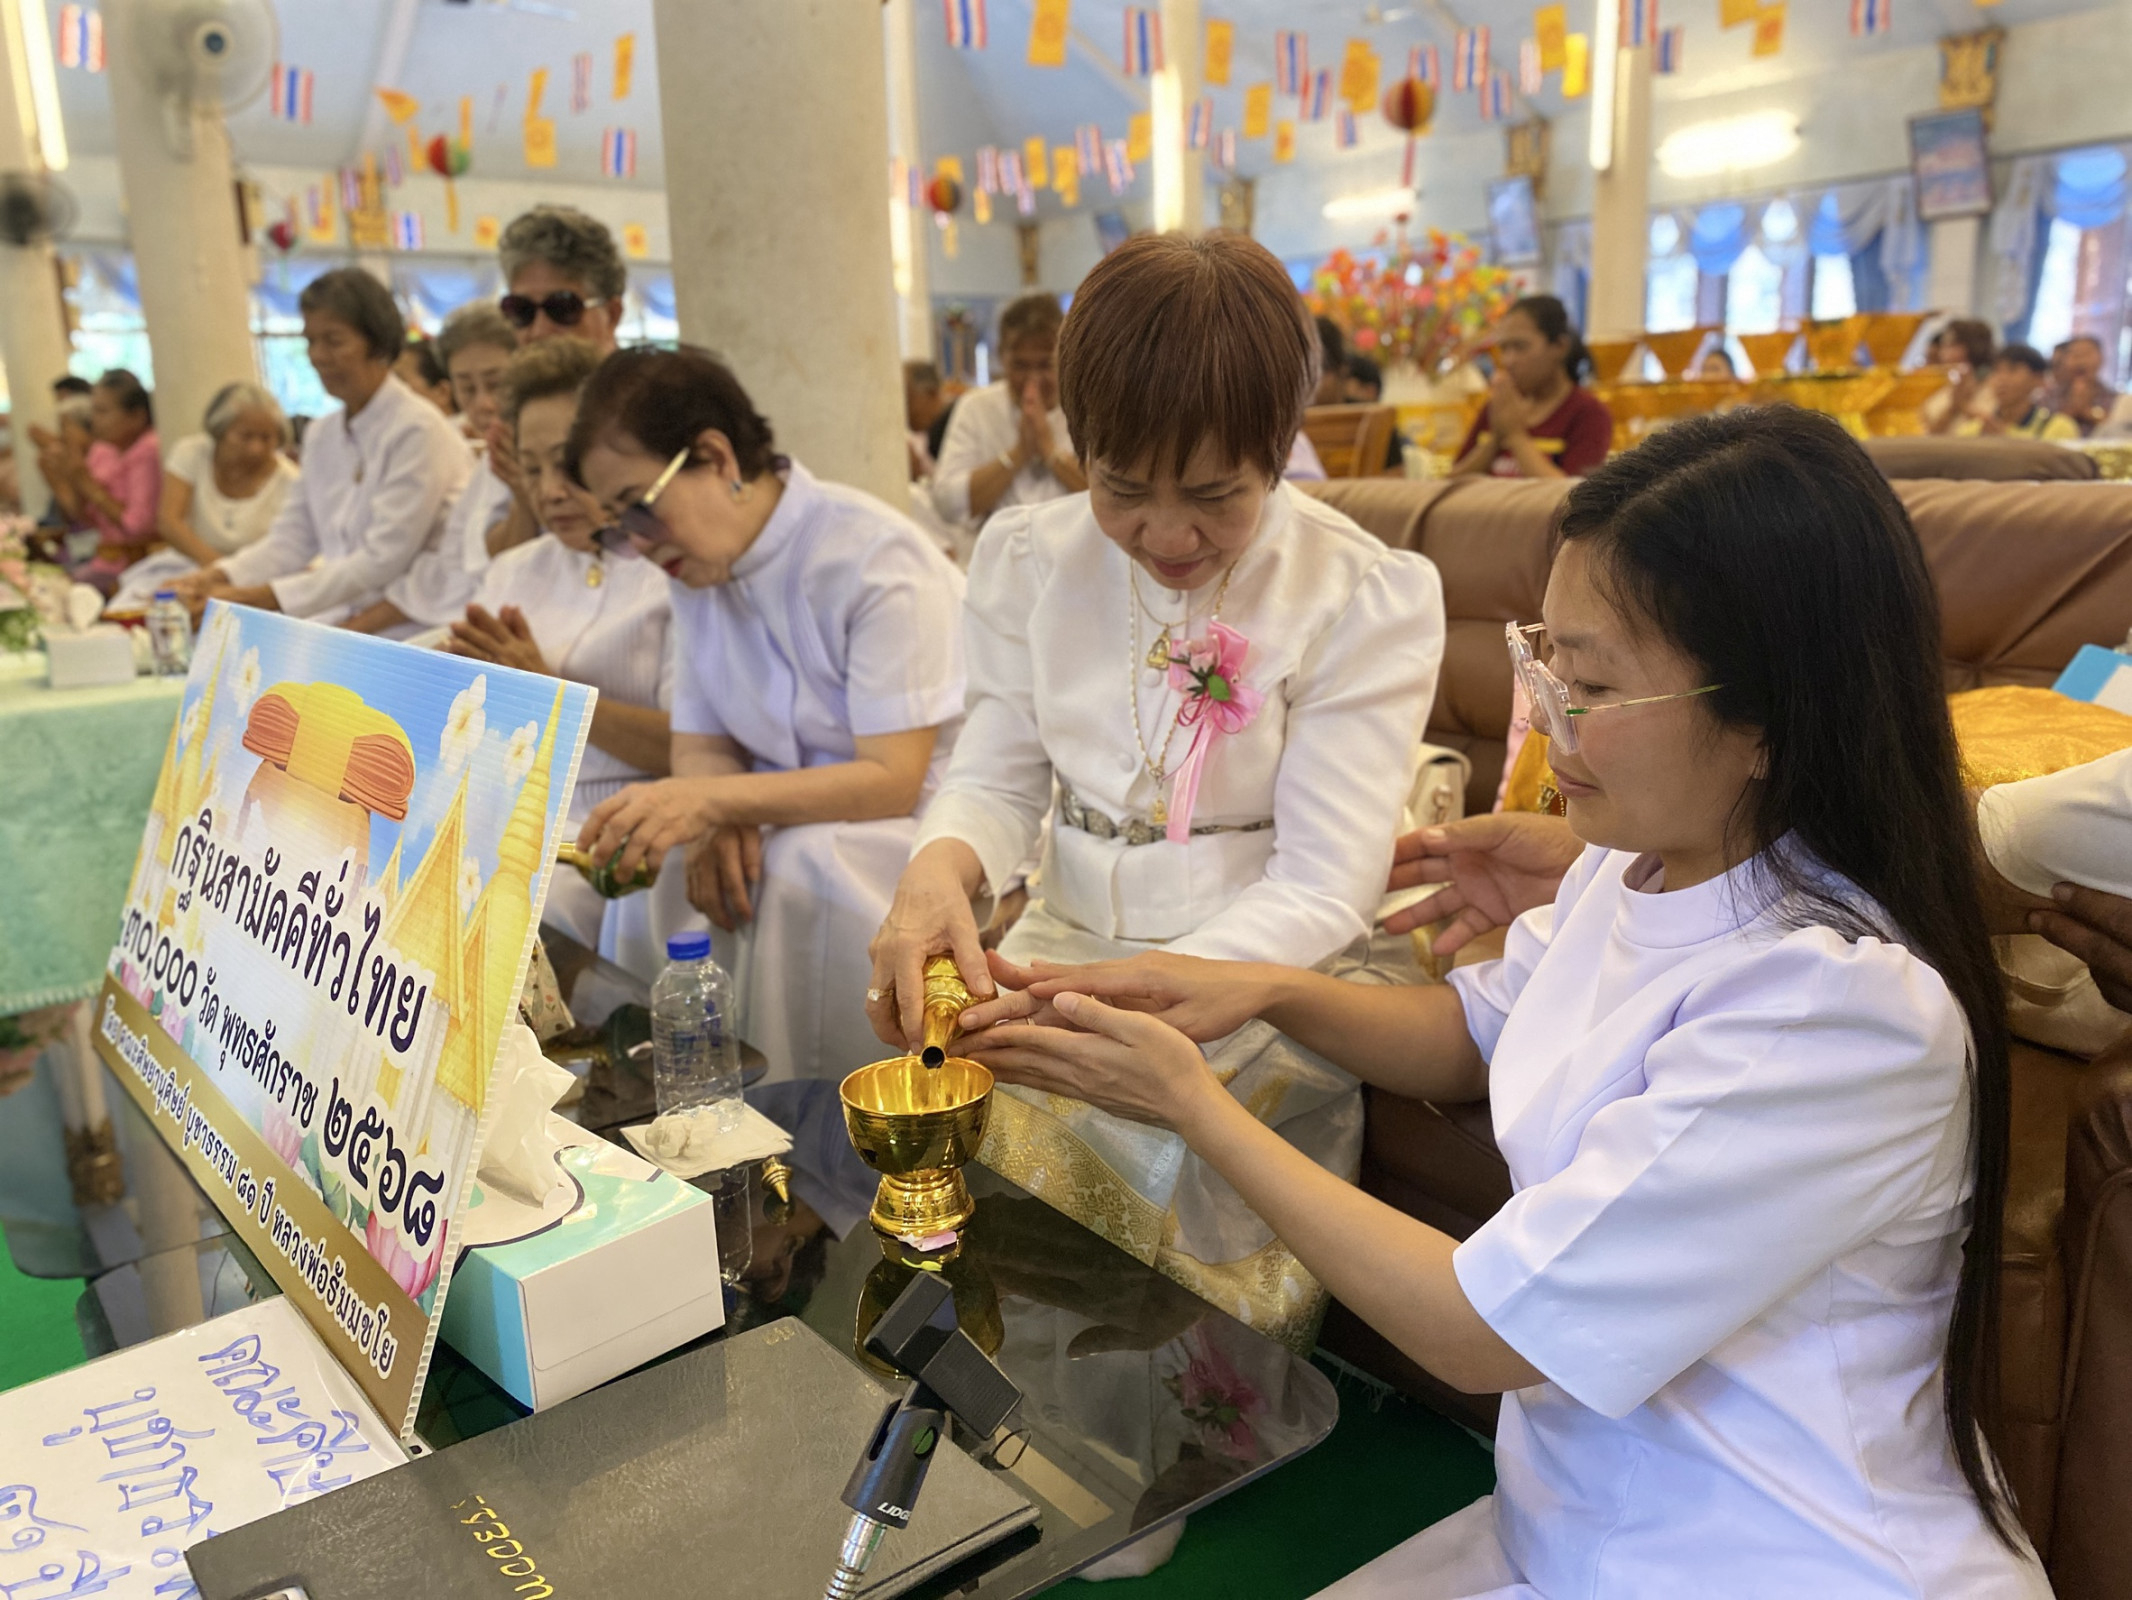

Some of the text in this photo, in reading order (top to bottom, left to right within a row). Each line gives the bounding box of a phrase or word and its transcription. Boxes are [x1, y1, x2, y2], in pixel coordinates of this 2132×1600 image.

[171, 807, 427, 1053] กฐินสามัคคีทั่วไทย
[184, 1106, 238, 1185] บูชาธรรม
[237, 1172, 256, 1210] ๘๑
[259, 1181, 274, 1224] ปี
[272, 1208, 395, 1373] หลวงพ่อธัมมชโย
[199, 966, 219, 1034] วัด
[219, 1004, 319, 1129] พุทธศักราช
[323, 1076, 445, 1247] ๒๕๖๘
